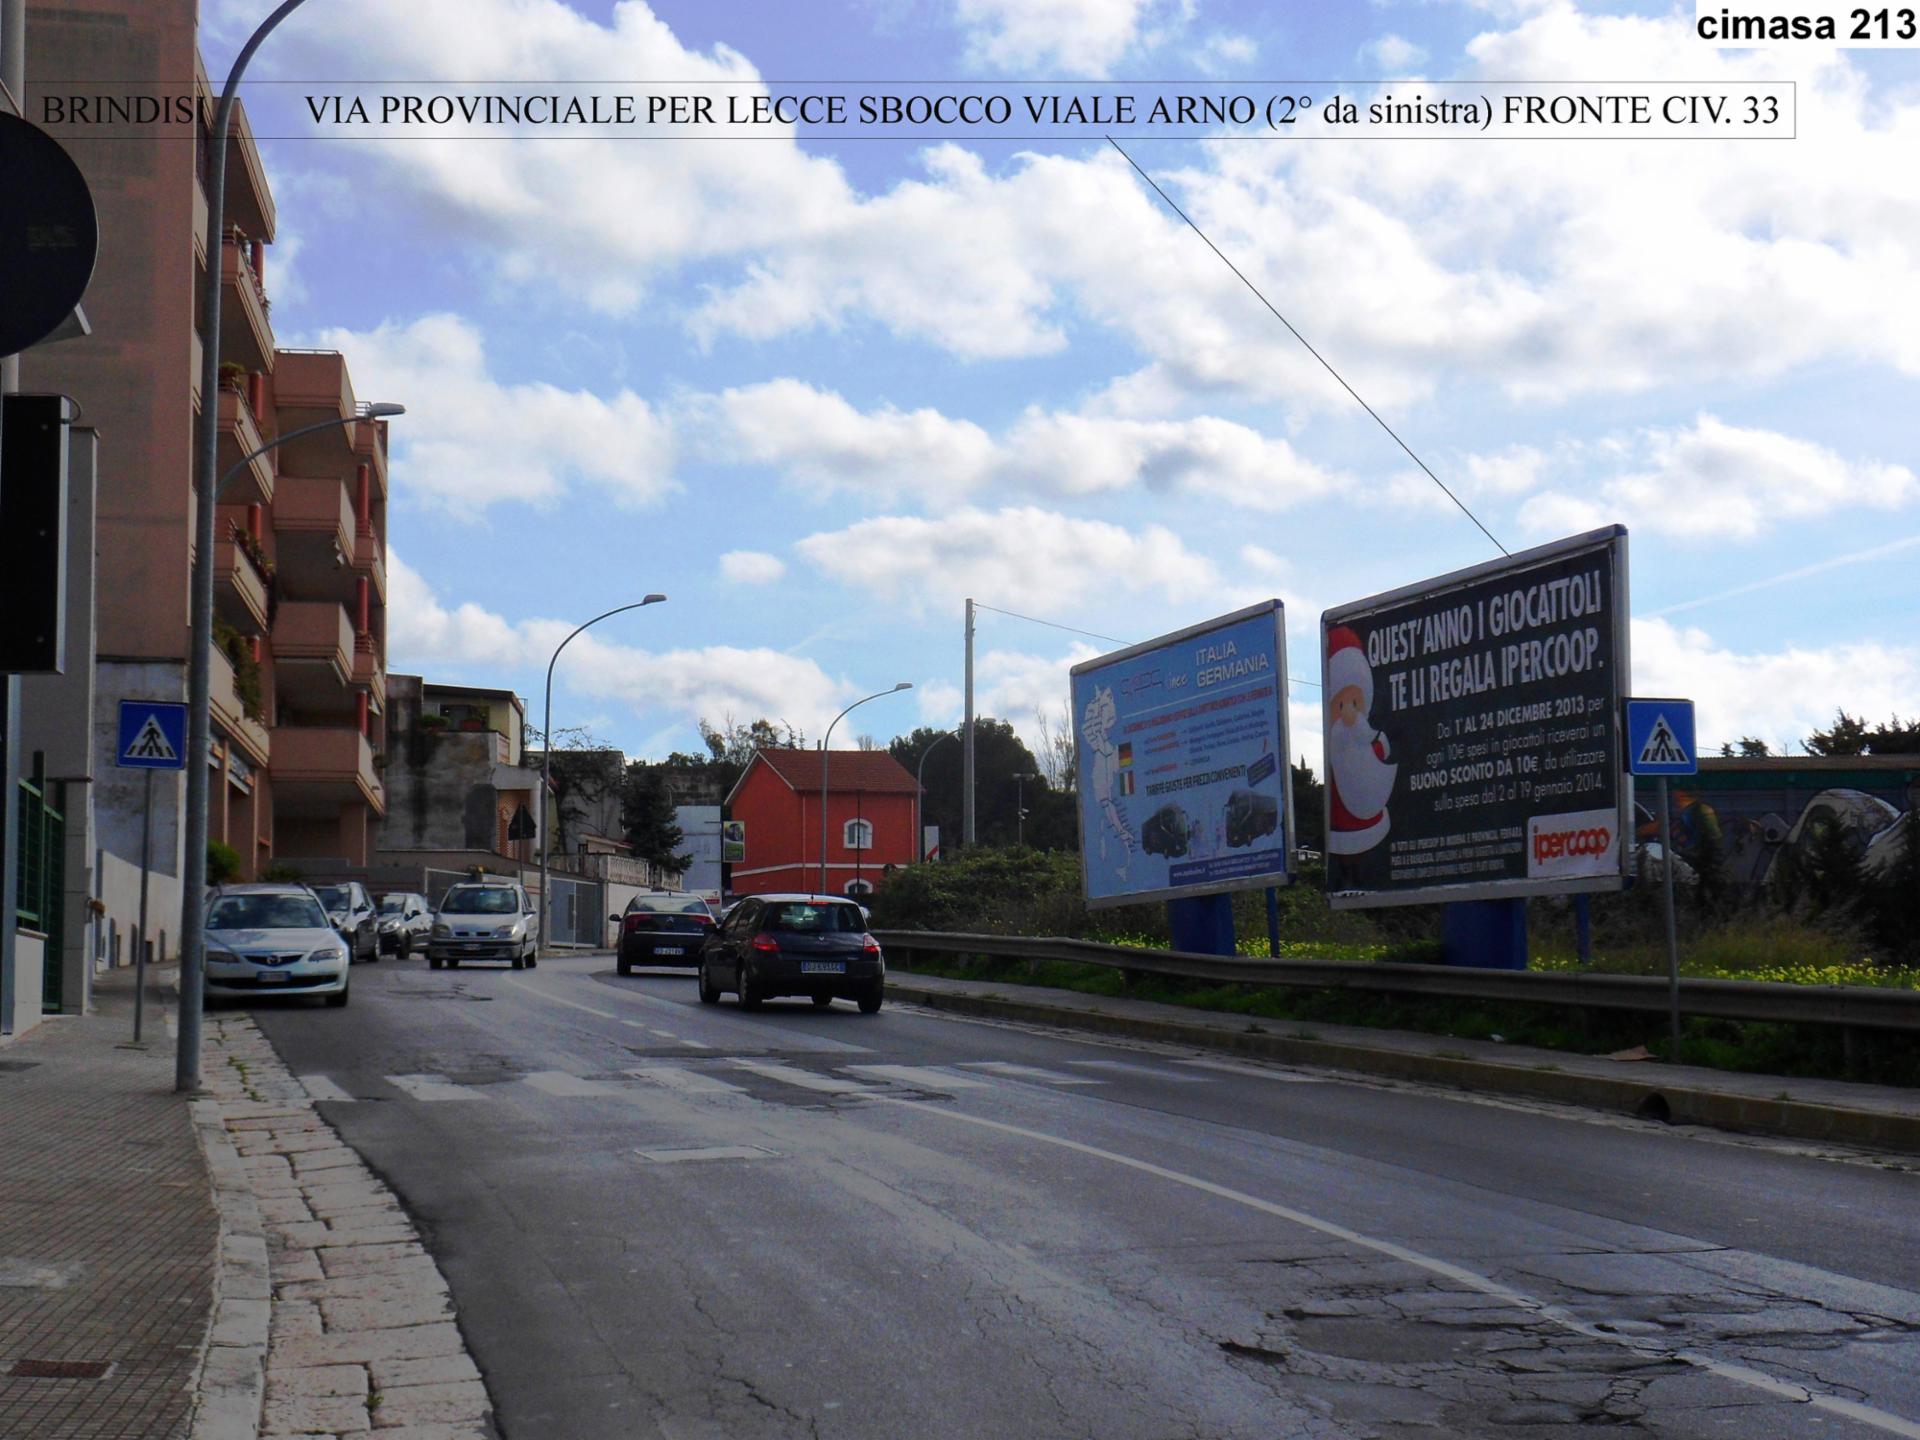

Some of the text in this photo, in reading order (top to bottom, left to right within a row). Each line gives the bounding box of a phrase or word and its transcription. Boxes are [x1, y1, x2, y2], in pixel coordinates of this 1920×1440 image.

[1368, 570, 1601, 668] QUEST'ANNO I GIOCATTOLI
[1196, 640, 1237, 666] ITALIA
[1196, 652, 1269, 687] GERMANIA
[1390, 627, 1603, 711] TE LI REGALA IPERCOOP.
[1465, 716, 1477, 733] AL
[1480, 712, 1494, 731] 24
[1497, 701, 1552, 727] DICEMBRE
[1556, 695, 1585, 717] 2013
[1588, 697, 1605, 717] per
[1593, 723, 1606, 738] un
[1410, 769, 1448, 791] BUONO
[1450, 761, 1494, 785] SCONTO
[1497, 758, 1513, 776] DA
[1544, 751, 1557, 770] da
[1455, 793, 1480, 813] spesa
[1481, 784, 1497, 804] dal
[1498, 783, 1505, 802] 2
[1520, 780, 1532, 799] 19
[1534, 777, 1574, 803] gennaio
[1533, 825, 1611, 865] ipercoop
